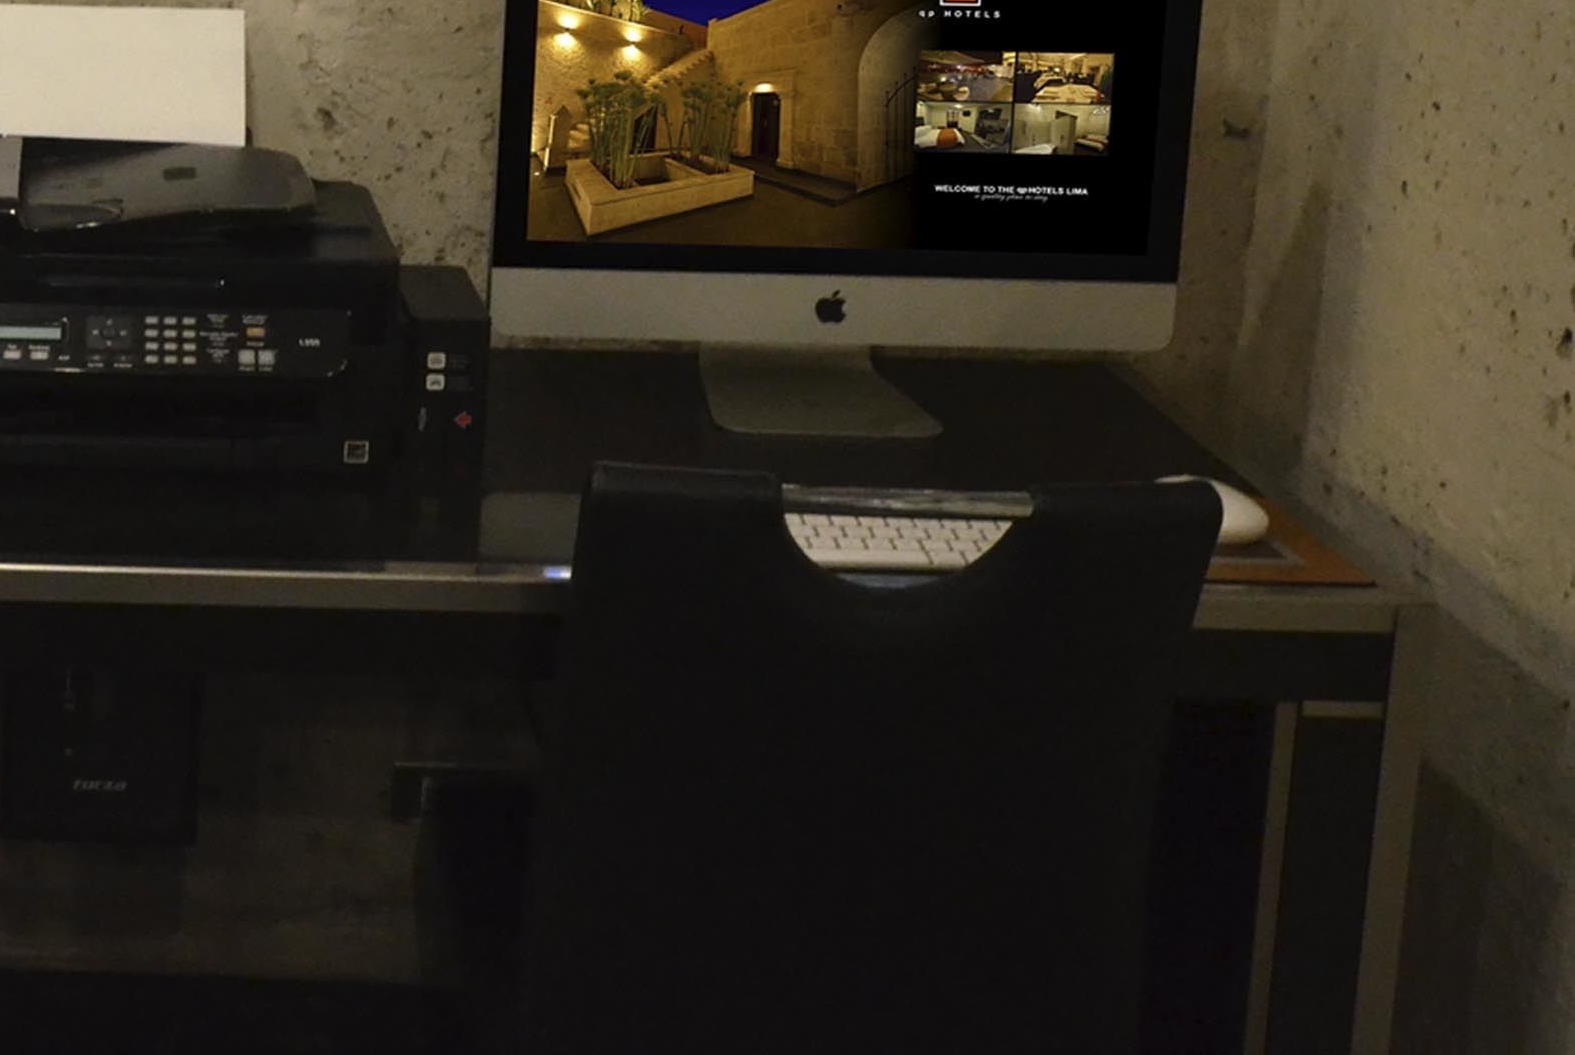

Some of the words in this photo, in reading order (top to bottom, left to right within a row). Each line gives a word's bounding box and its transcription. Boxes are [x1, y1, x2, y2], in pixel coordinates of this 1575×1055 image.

[943, 10, 1001, 19] HOTELS
[933, 184, 980, 193] WELCOME
[983, 185, 995, 193] TO
[998, 185, 1014, 193] THE
[1066, 187, 1089, 195] LIMA
